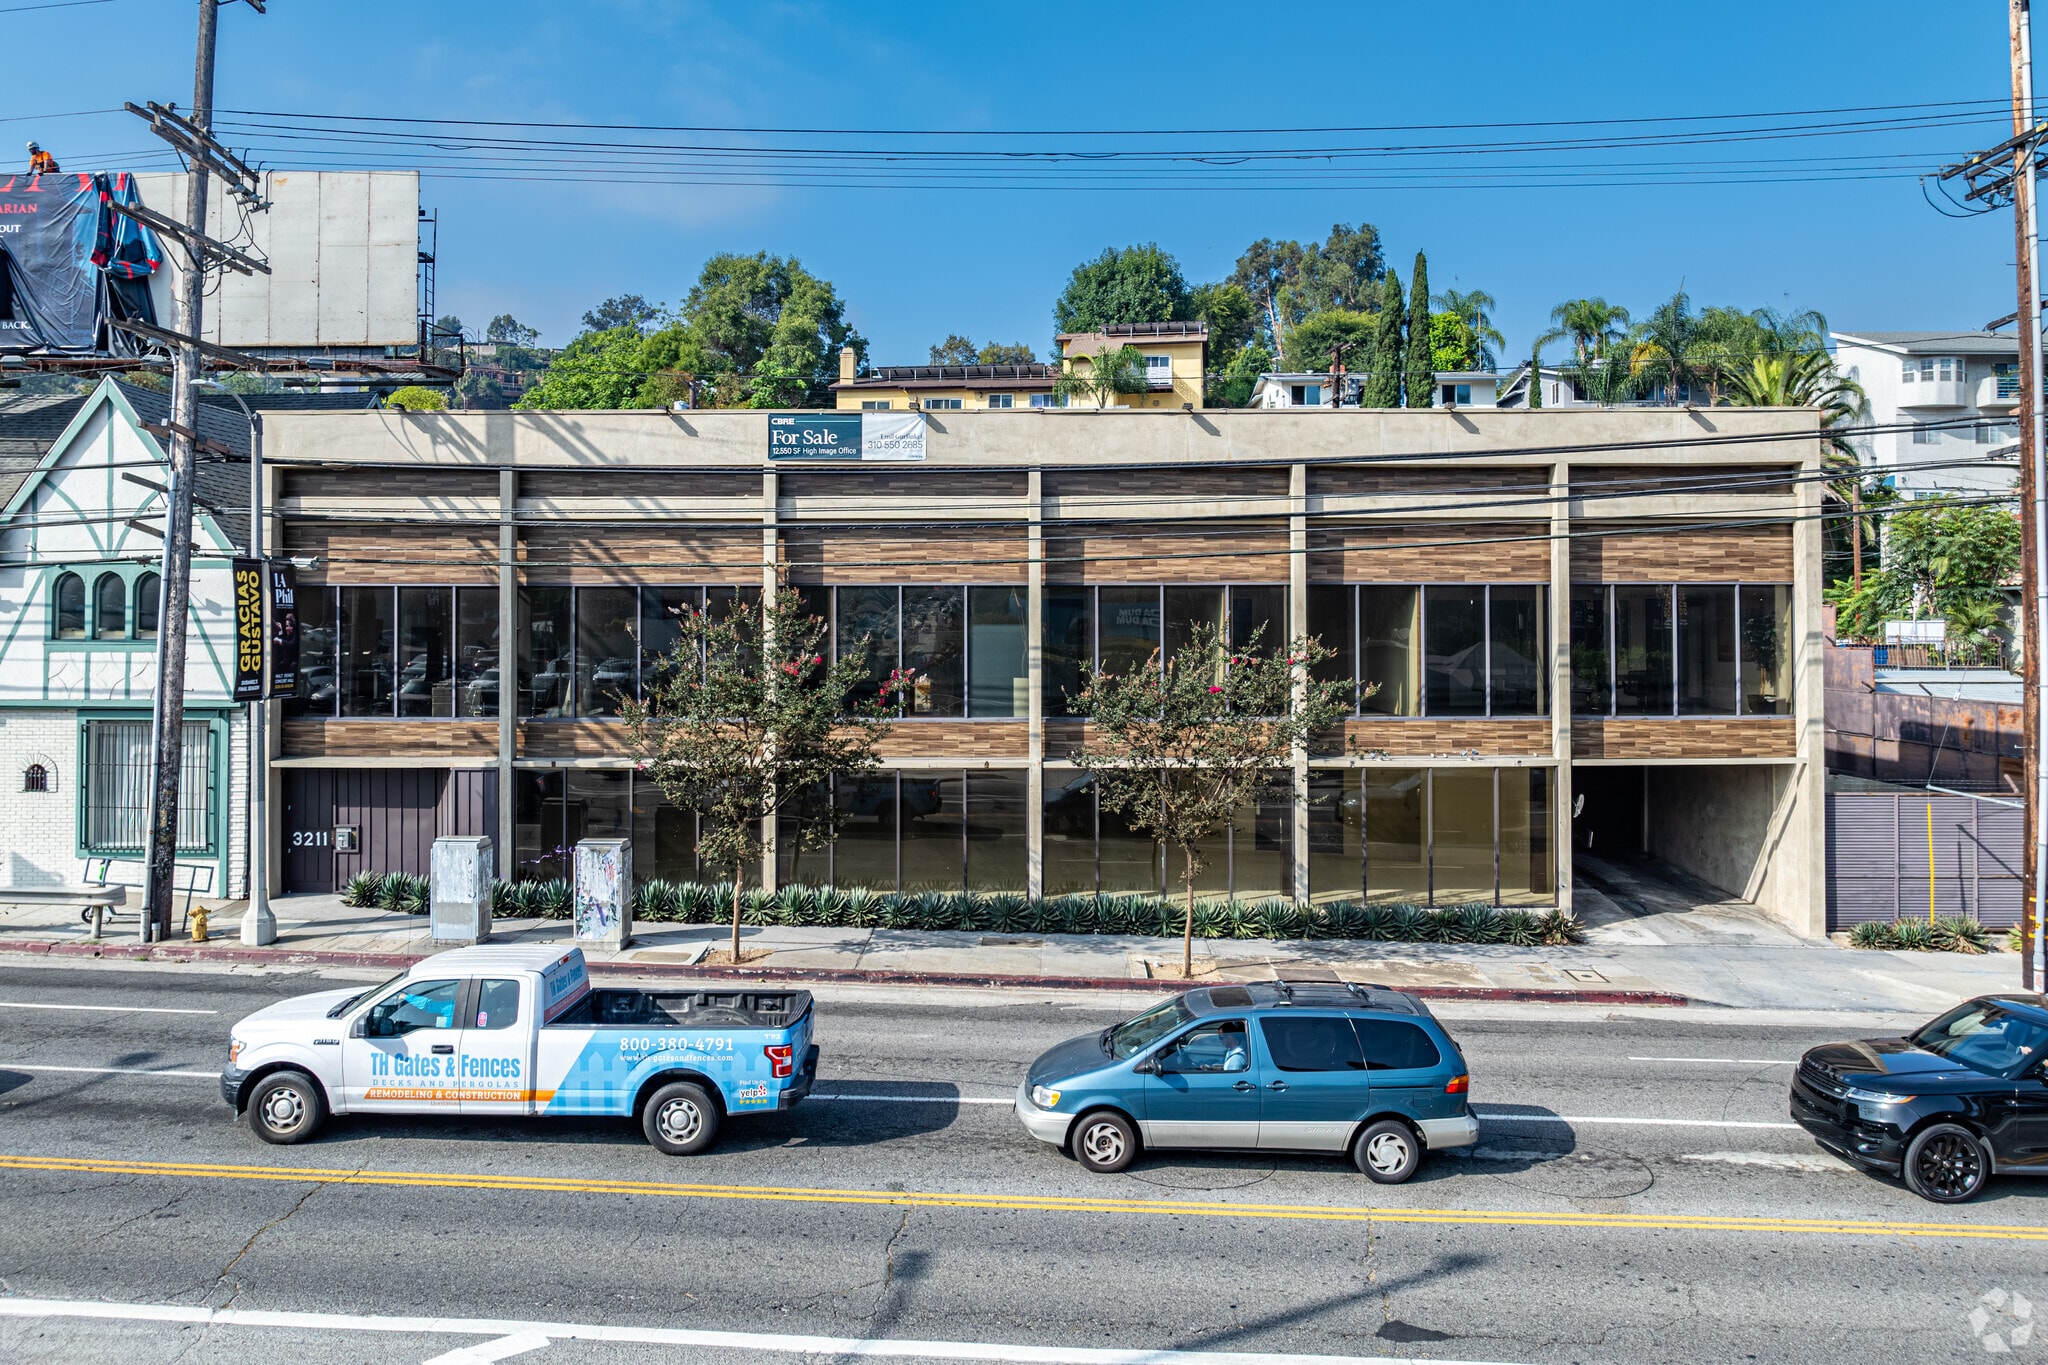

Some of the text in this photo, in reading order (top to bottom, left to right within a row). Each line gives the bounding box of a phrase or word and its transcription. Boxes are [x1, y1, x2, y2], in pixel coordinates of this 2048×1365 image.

[771, 417, 795, 425] CBRE
[772, 428, 838, 445] For Sale
[793, 447, 800, 455] SF
[803, 447, 817, 456] High
[818, 447, 837, 456] Image
[838, 446, 857, 455] Office
[868, 440, 882, 449] 310
[884, 440, 900, 449] 550
[274, 573, 287, 587] LA
[275, 588, 293, 603] Phil
[236, 570, 251, 672] GRACIAS
[248, 571, 261, 672] GUSTAVO
[293, 831, 327, 846] 3211
[620, 1037, 734, 1051] 800-380-4791
[371, 1052, 521, 1079] TH Gates & Fences
[372, 1079, 520, 1088] DECKS AND PERGOLAS
[369, 1089, 521, 1100] REMODELING & CONSTRUCTION
[740, 1088, 758, 1098] yelp
